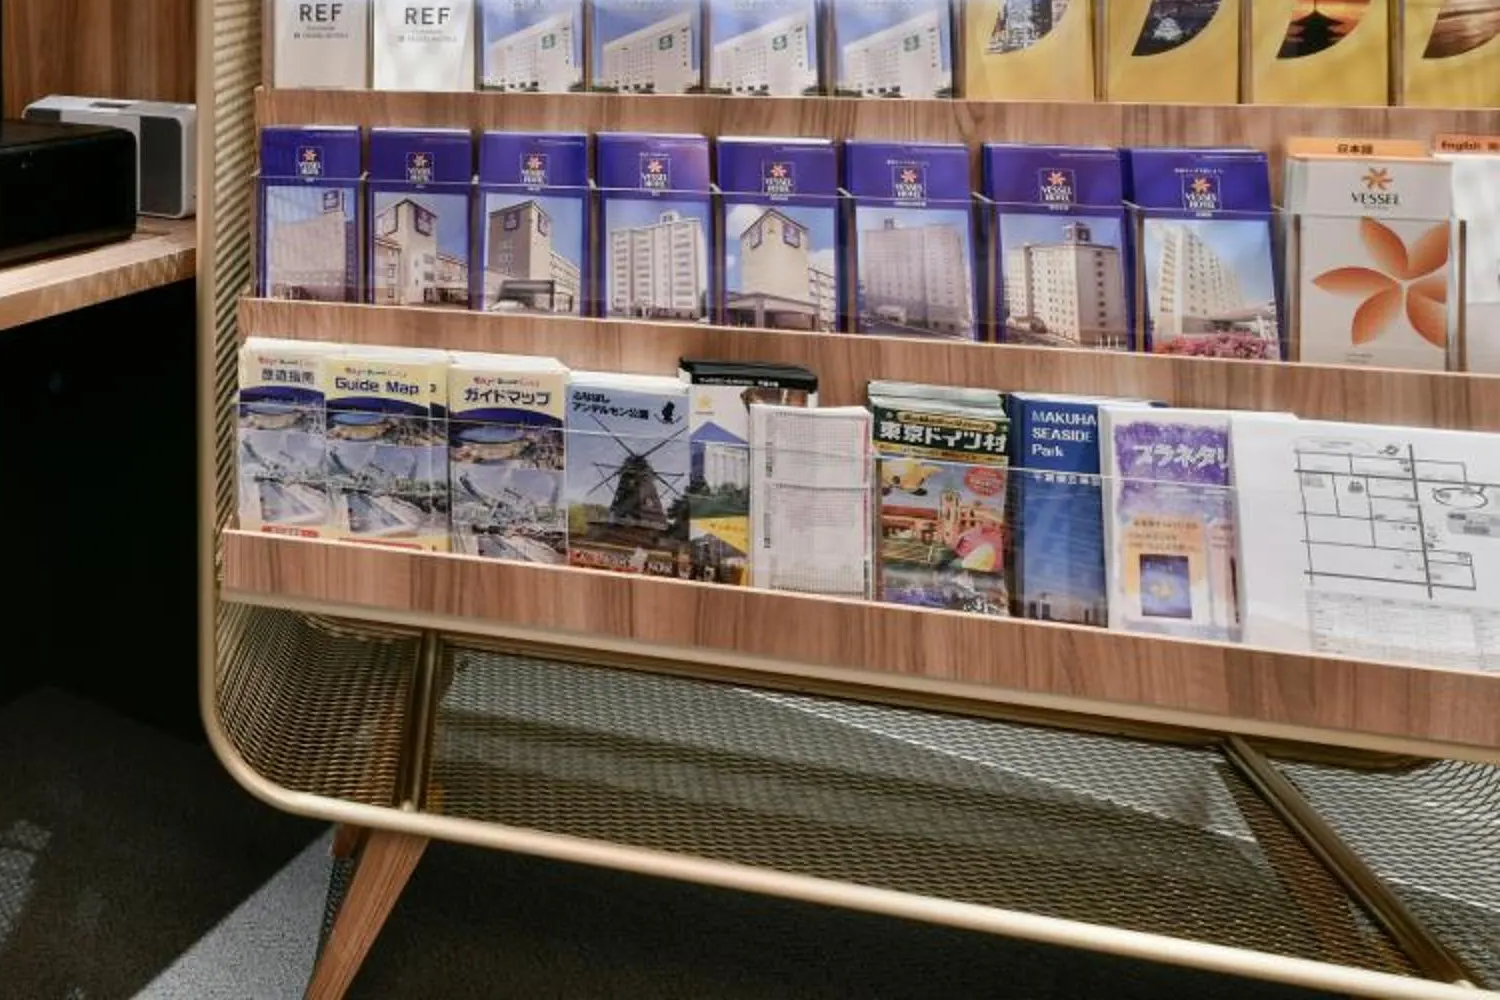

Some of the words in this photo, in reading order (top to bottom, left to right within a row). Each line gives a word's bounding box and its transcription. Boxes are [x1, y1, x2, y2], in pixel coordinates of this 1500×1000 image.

[299, 3, 344, 22] REF
[405, 7, 452, 25] REF
[1351, 192, 1401, 206] VESSEL
[335, 377, 381, 394] Guide
[386, 381, 420, 397] Map
[464, 387, 552, 405] ガイドマップ
[880, 420, 1008, 452] 東京ドイツ村
[1031, 427, 1093, 442] SEASIDE
[1031, 443, 1065, 457] Park
